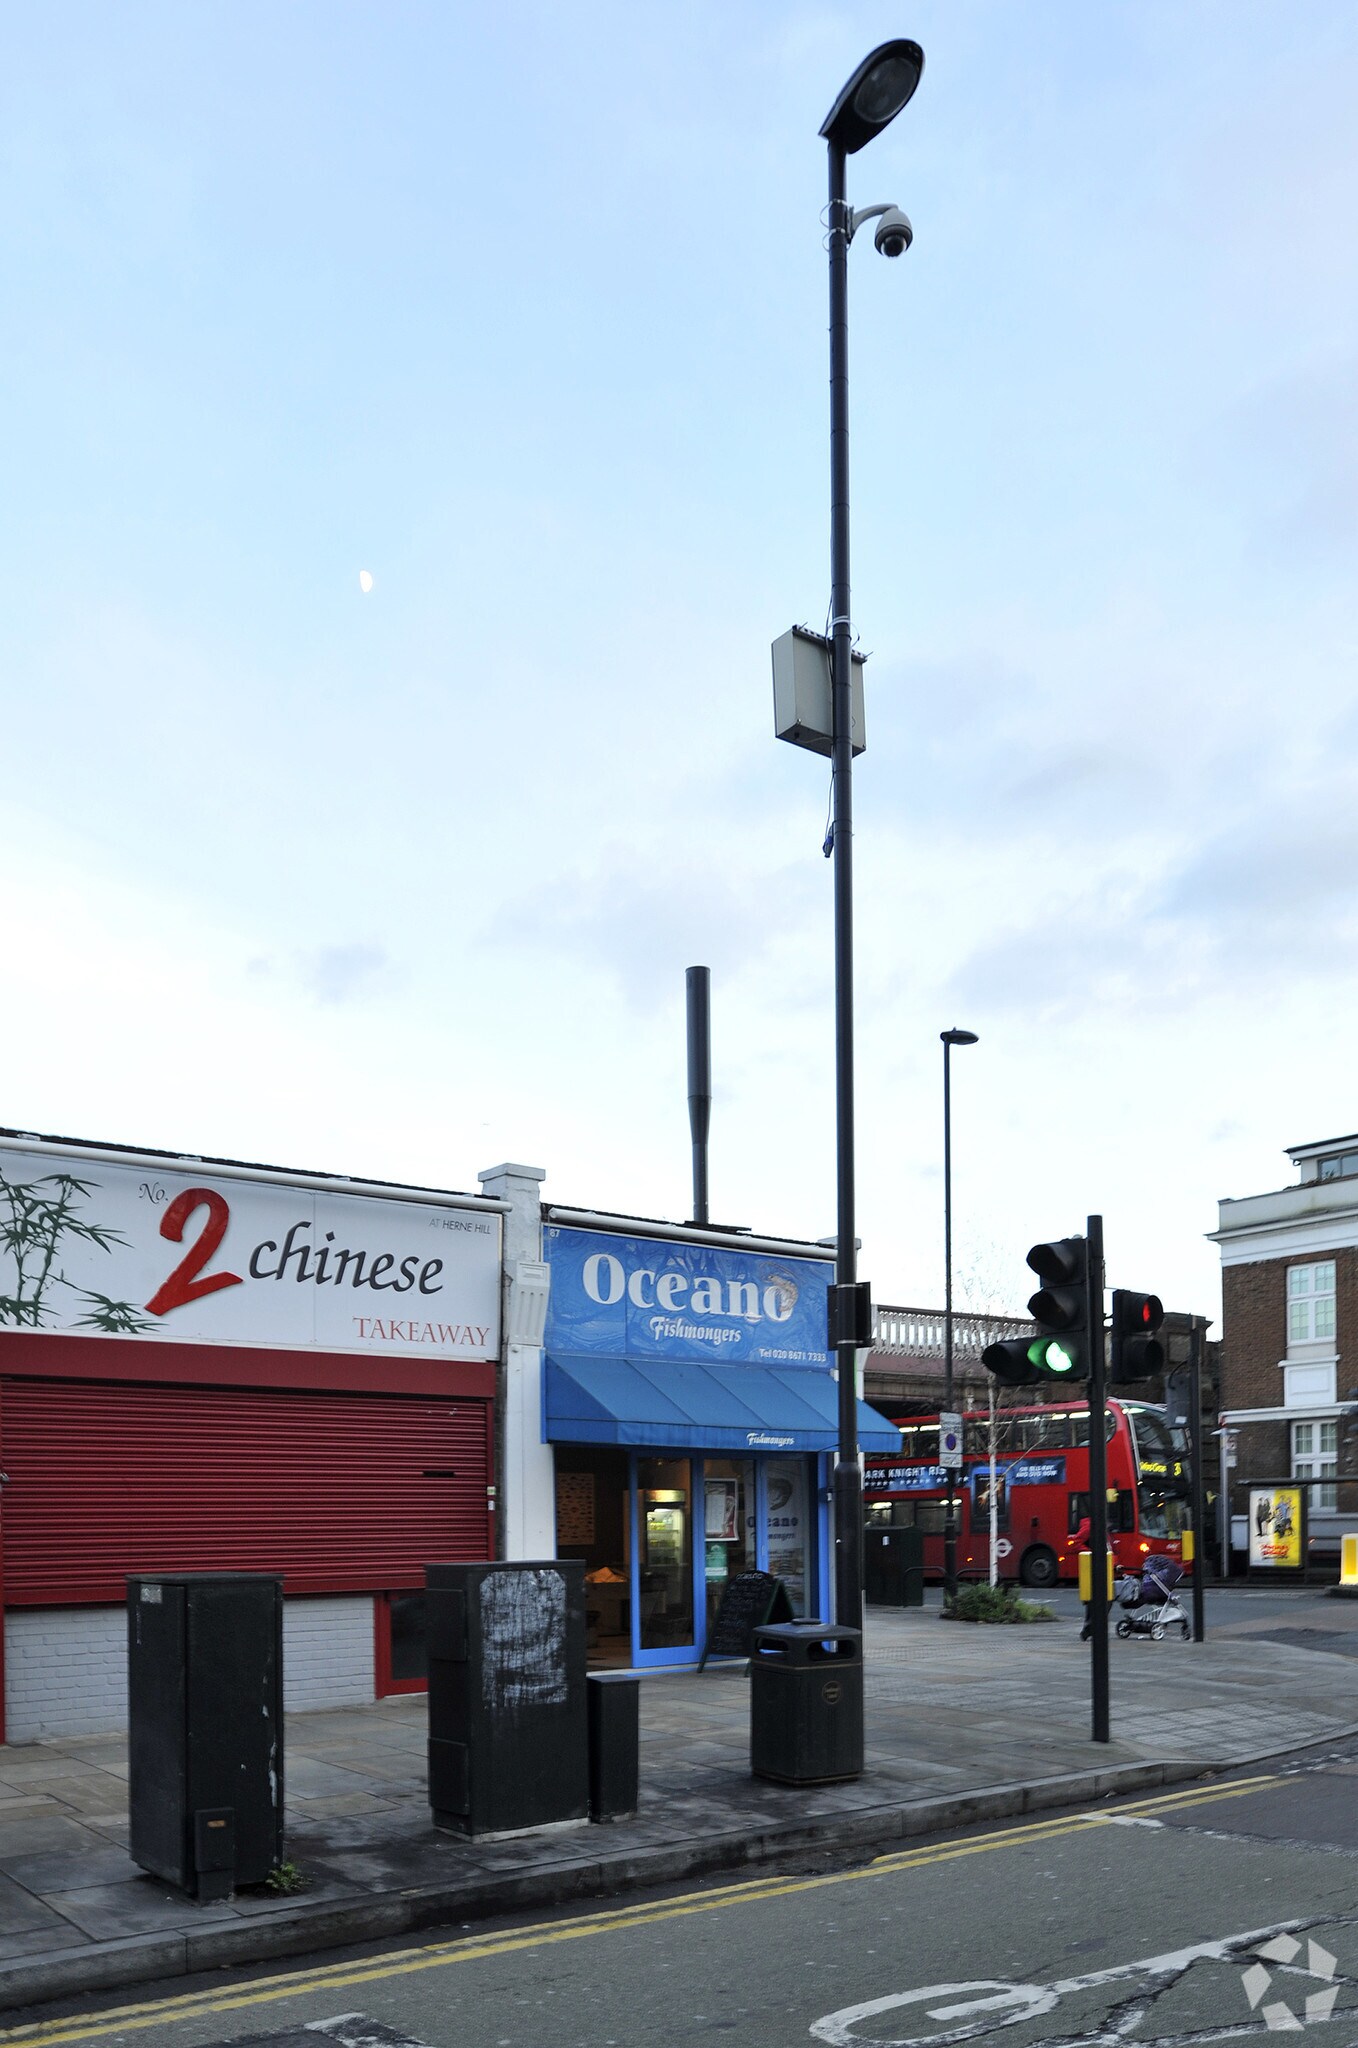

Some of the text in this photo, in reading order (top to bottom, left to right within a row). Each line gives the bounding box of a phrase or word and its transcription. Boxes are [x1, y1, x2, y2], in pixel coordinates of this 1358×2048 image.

[429, 1218, 491, 1235] AT HERNE HILL
[138, 1182, 444, 1316] No. 2 chinese
[582, 1253, 797, 1322] Oceano
[352, 1316, 490, 1347] TAKEAWAY
[649, 1315, 742, 1346] Fishmongers
[759, 1348, 772, 1358] Tel
[772, 1349, 788, 1359] 020
[746, 1432, 795, 1447] Fishmongers
[865, 1465, 947, 1479] ARK KNIGHT RIS
